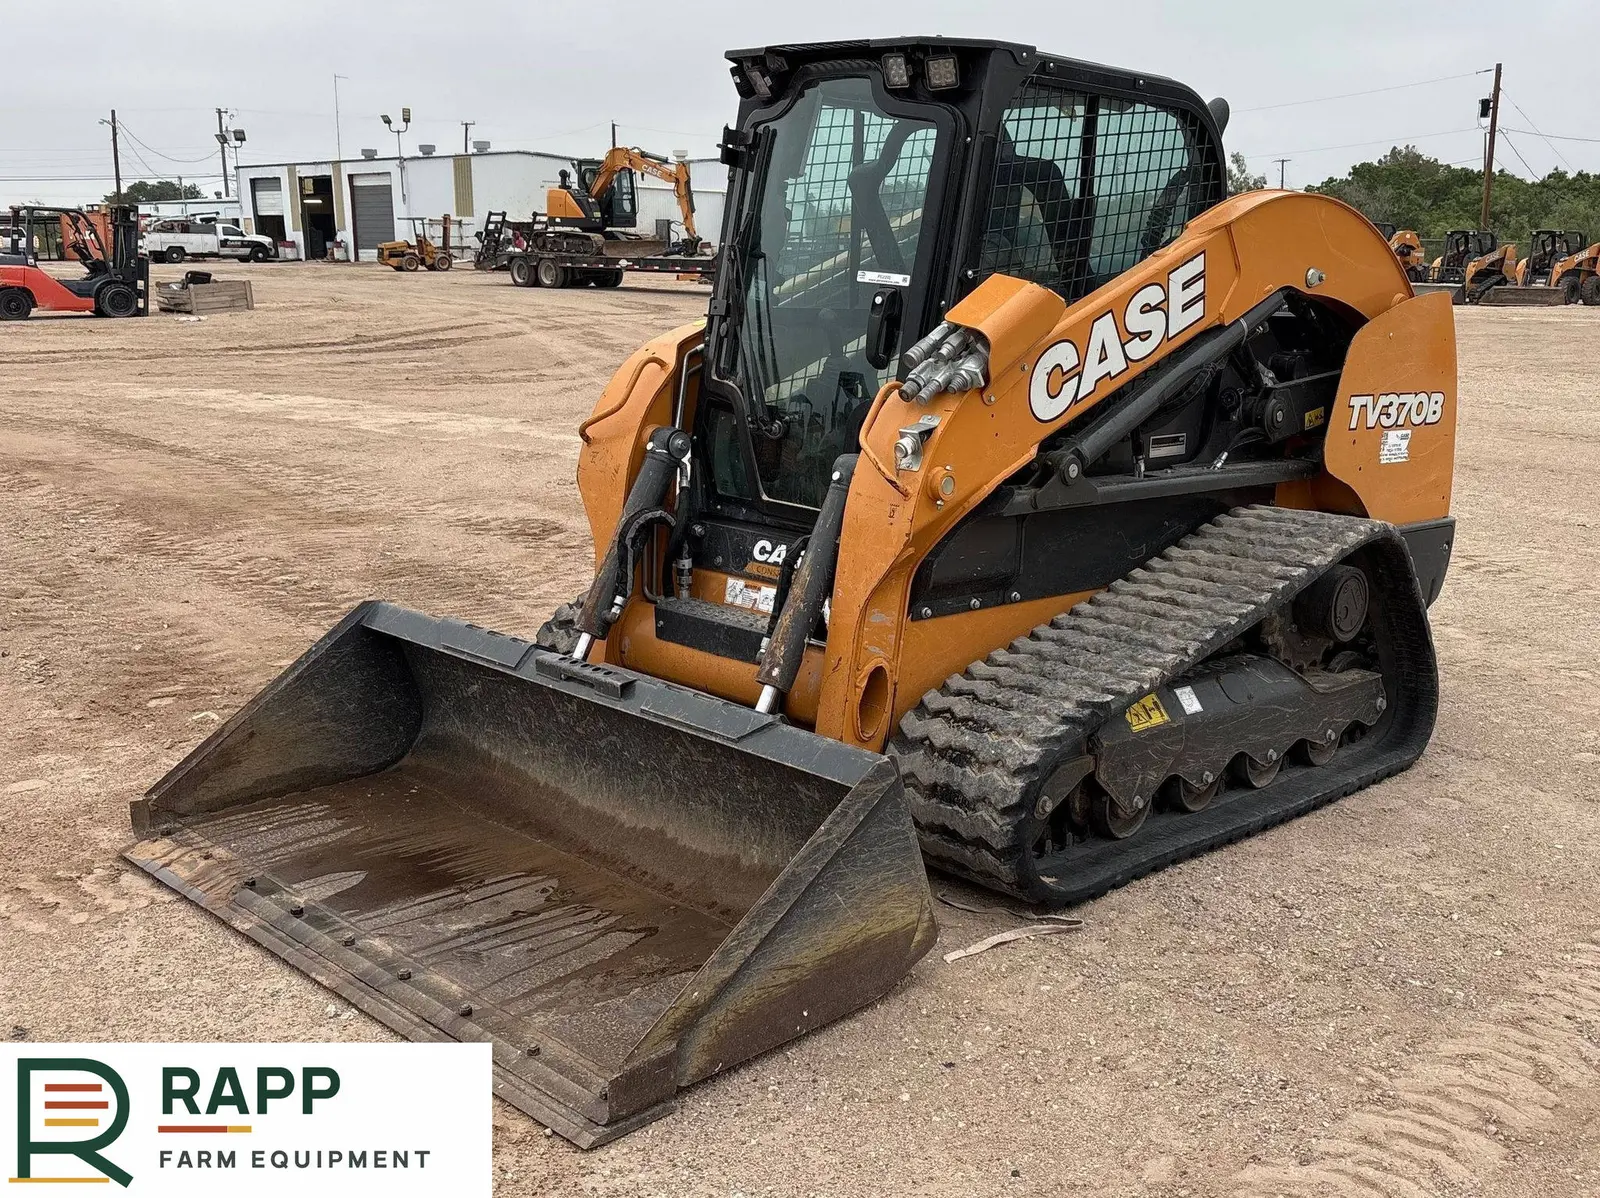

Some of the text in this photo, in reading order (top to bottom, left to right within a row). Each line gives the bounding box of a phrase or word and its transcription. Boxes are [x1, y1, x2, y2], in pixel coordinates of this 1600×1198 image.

[641, 164, 663, 177] CASE
[1574, 249, 1590, 263] CASE
[1029, 249, 1206, 424] CASE
[1348, 390, 1446, 431] TV370B
